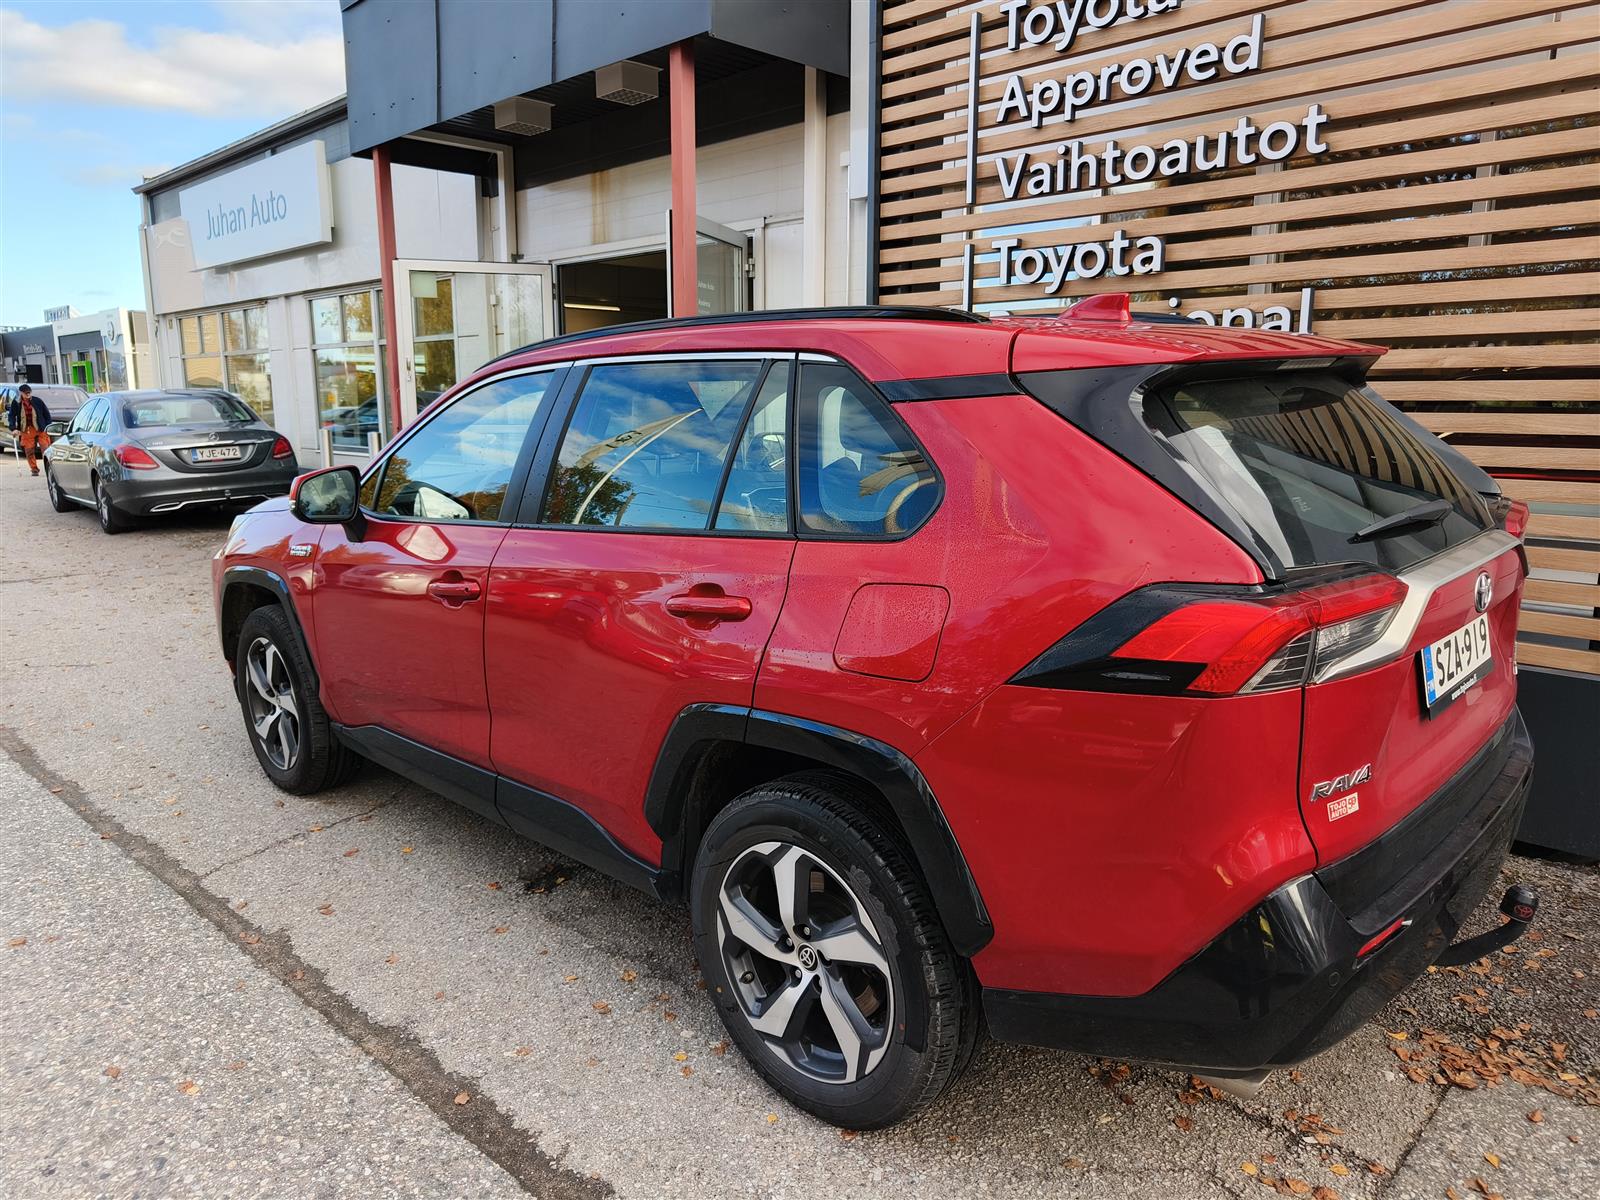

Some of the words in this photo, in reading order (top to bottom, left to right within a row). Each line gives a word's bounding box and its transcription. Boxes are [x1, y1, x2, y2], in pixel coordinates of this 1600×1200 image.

[996, 13, 1266, 128] Approved
[995, 103, 1330, 200] Vaihtoautot
[207, 202, 247, 240] Juhan
[250, 191, 287, 228] Auto
[992, 229, 1166, 294] Toyota
[1310, 763, 1372, 802] RAV4
[1330, 807, 1347, 819] AUTO
